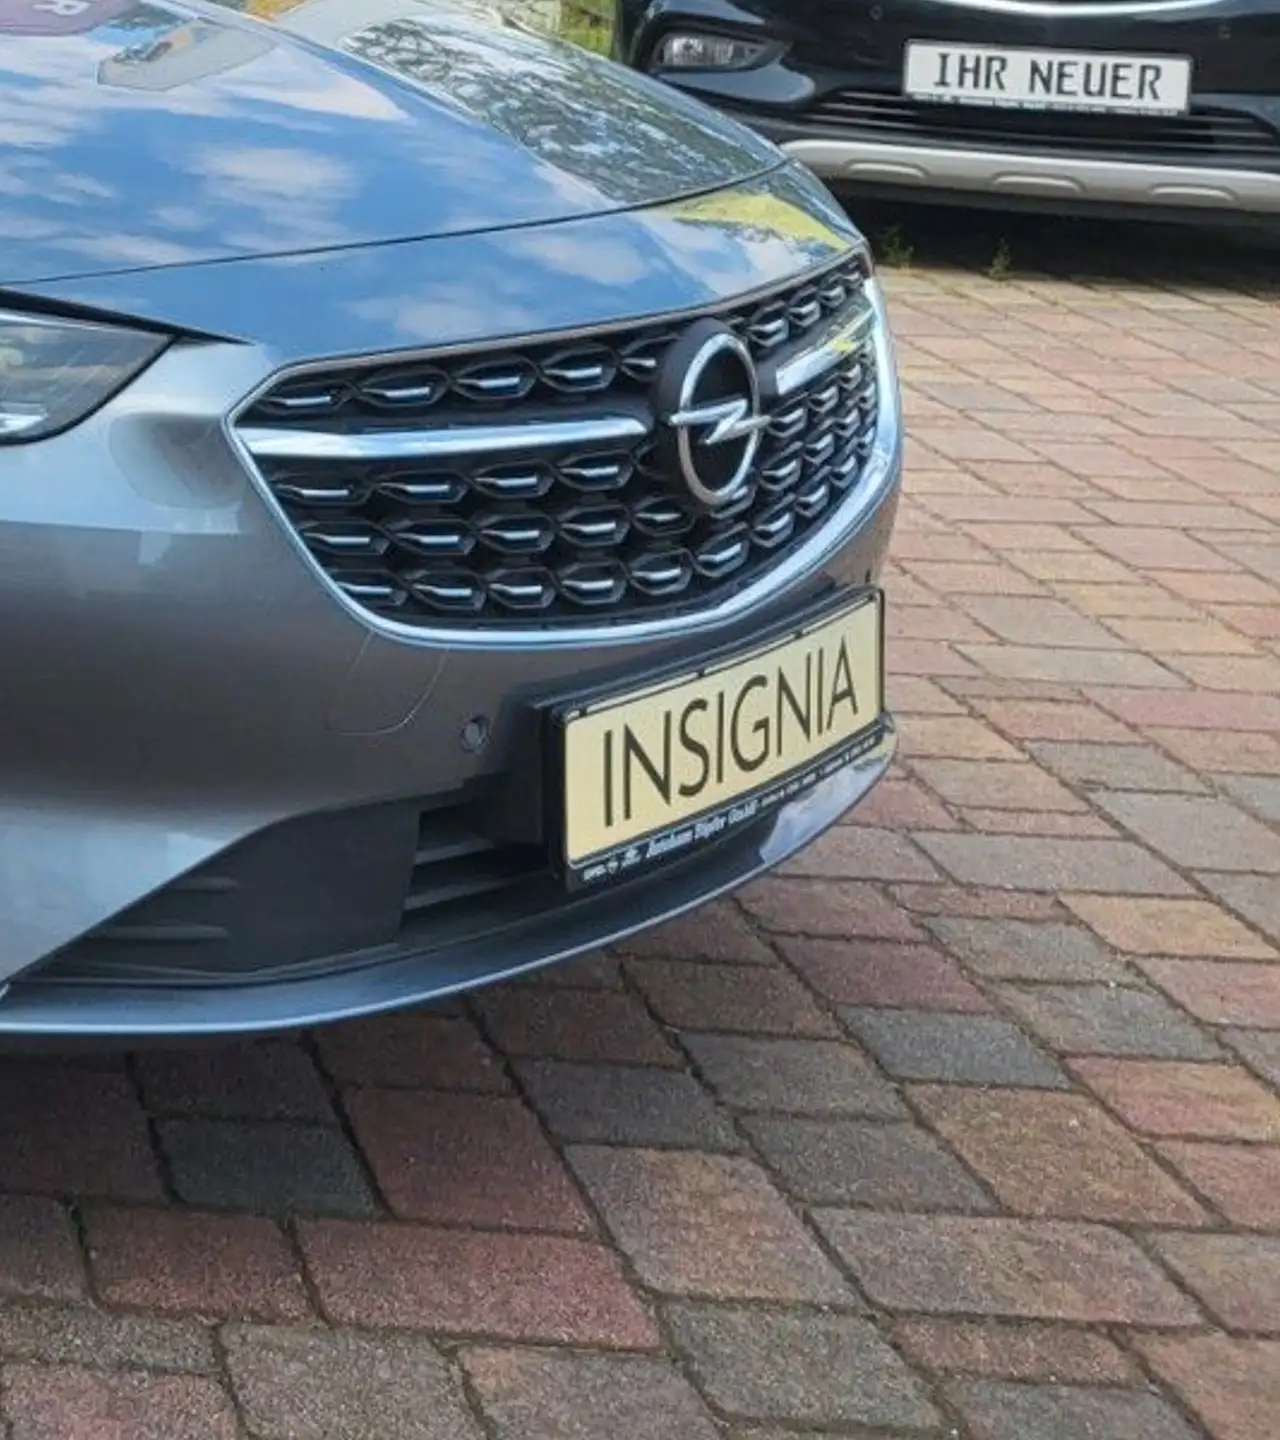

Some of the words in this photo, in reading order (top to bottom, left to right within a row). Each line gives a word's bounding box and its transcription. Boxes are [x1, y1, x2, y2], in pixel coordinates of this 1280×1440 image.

[933, 52, 1008, 91] IHR
[1028, 59, 1163, 101] NEUER
[603, 635, 859, 828] INSIGNIA
